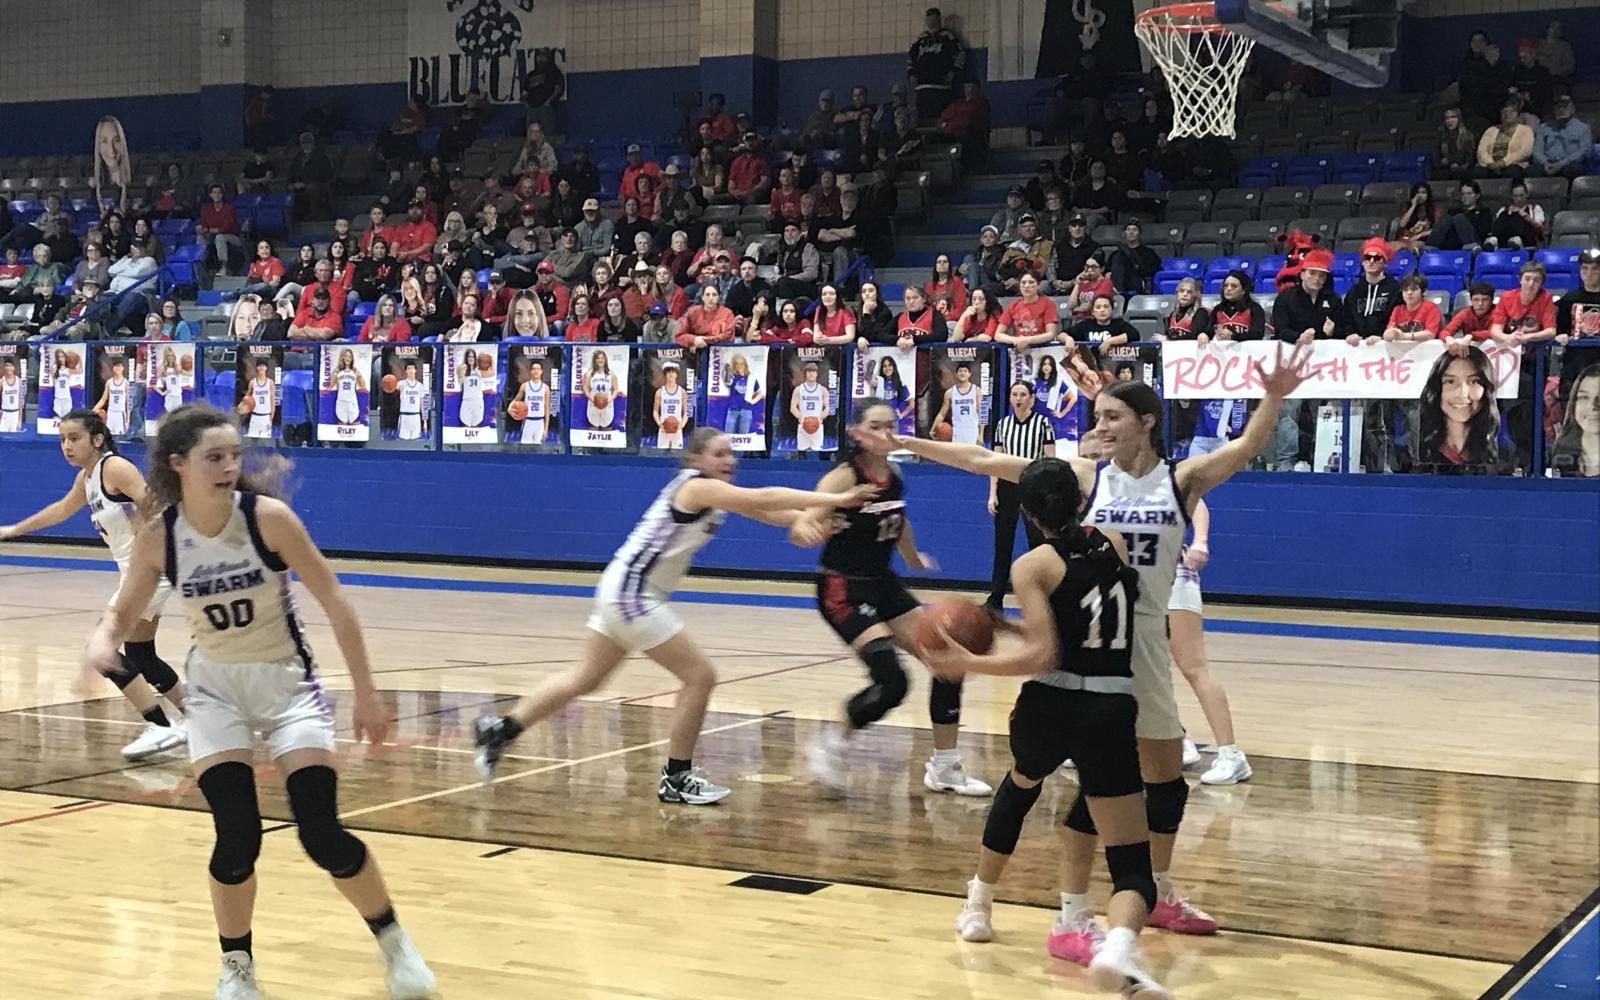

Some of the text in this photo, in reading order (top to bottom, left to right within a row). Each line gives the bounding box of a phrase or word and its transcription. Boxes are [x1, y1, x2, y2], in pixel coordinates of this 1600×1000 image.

[104, 345, 125, 354] BLUECAT
[250, 346, 272, 354] BLUECAT
[396, 346, 420, 355] BLUECAT
[523, 346, 548, 355] BLUECAT
[657, 349, 683, 358] BLUECAT
[798, 347, 825, 357] BLUECAT
[947, 347, 977, 357] BLUECAT
[1165, 353, 1415, 394] ROCK ITH THE
[469, 379, 478, 387] 34
[828, 370, 837, 388] CODY
[806, 402, 815, 411] 23
[960, 405, 970, 415] 24
[337, 427, 356, 435] RILEY
[464, 429, 480, 437] LILY
[587, 432, 612, 441] JAYLIE
[1094, 508, 1178, 526] SWARM
[182, 568, 266, 598] SWARM
[203, 599, 255, 631] 00
[1080, 580, 1128, 649] 11
